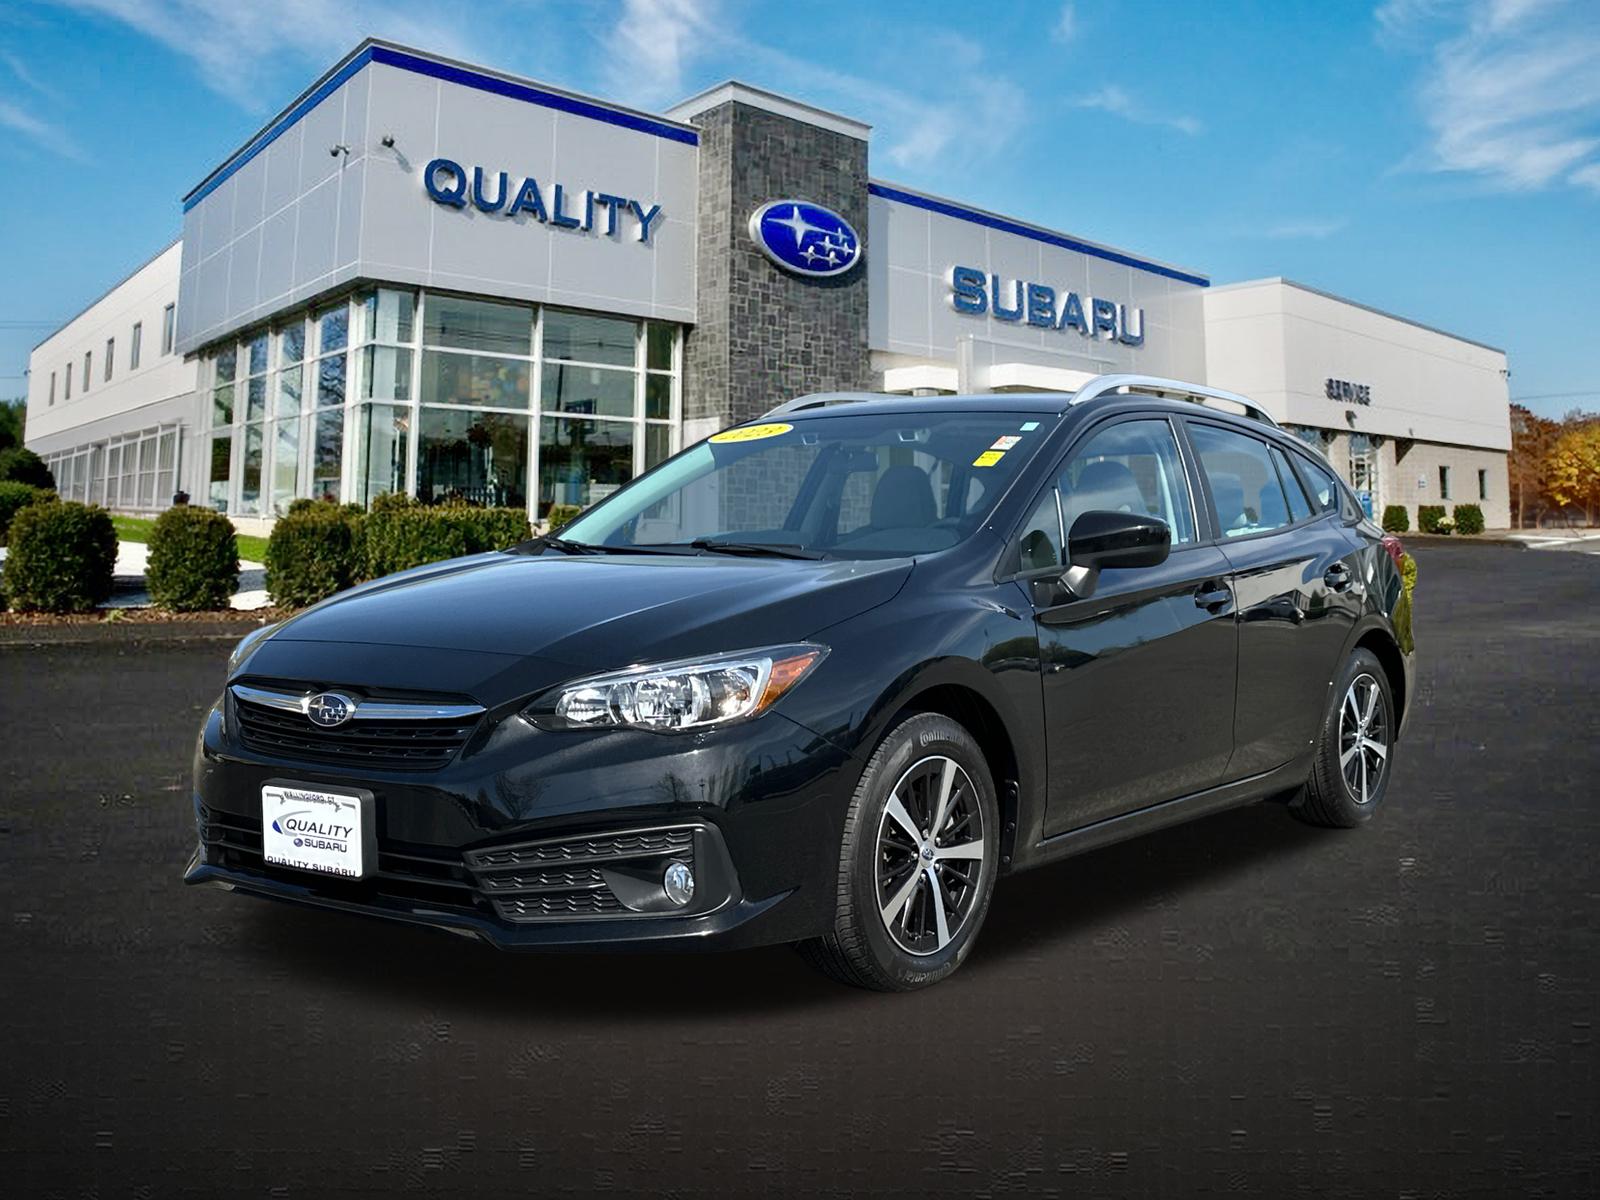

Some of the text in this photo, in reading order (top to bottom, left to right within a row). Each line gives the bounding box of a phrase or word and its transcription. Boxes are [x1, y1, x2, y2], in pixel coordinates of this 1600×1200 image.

[424, 158, 661, 243] QUALITY
[952, 265, 1145, 346] SUBARU
[1325, 378, 1371, 406] SERVICE
[286, 818, 353, 838] QUALITY
[304, 838, 347, 853] SUBARU
[267, 855, 356, 877] QUALITY SUBARU
